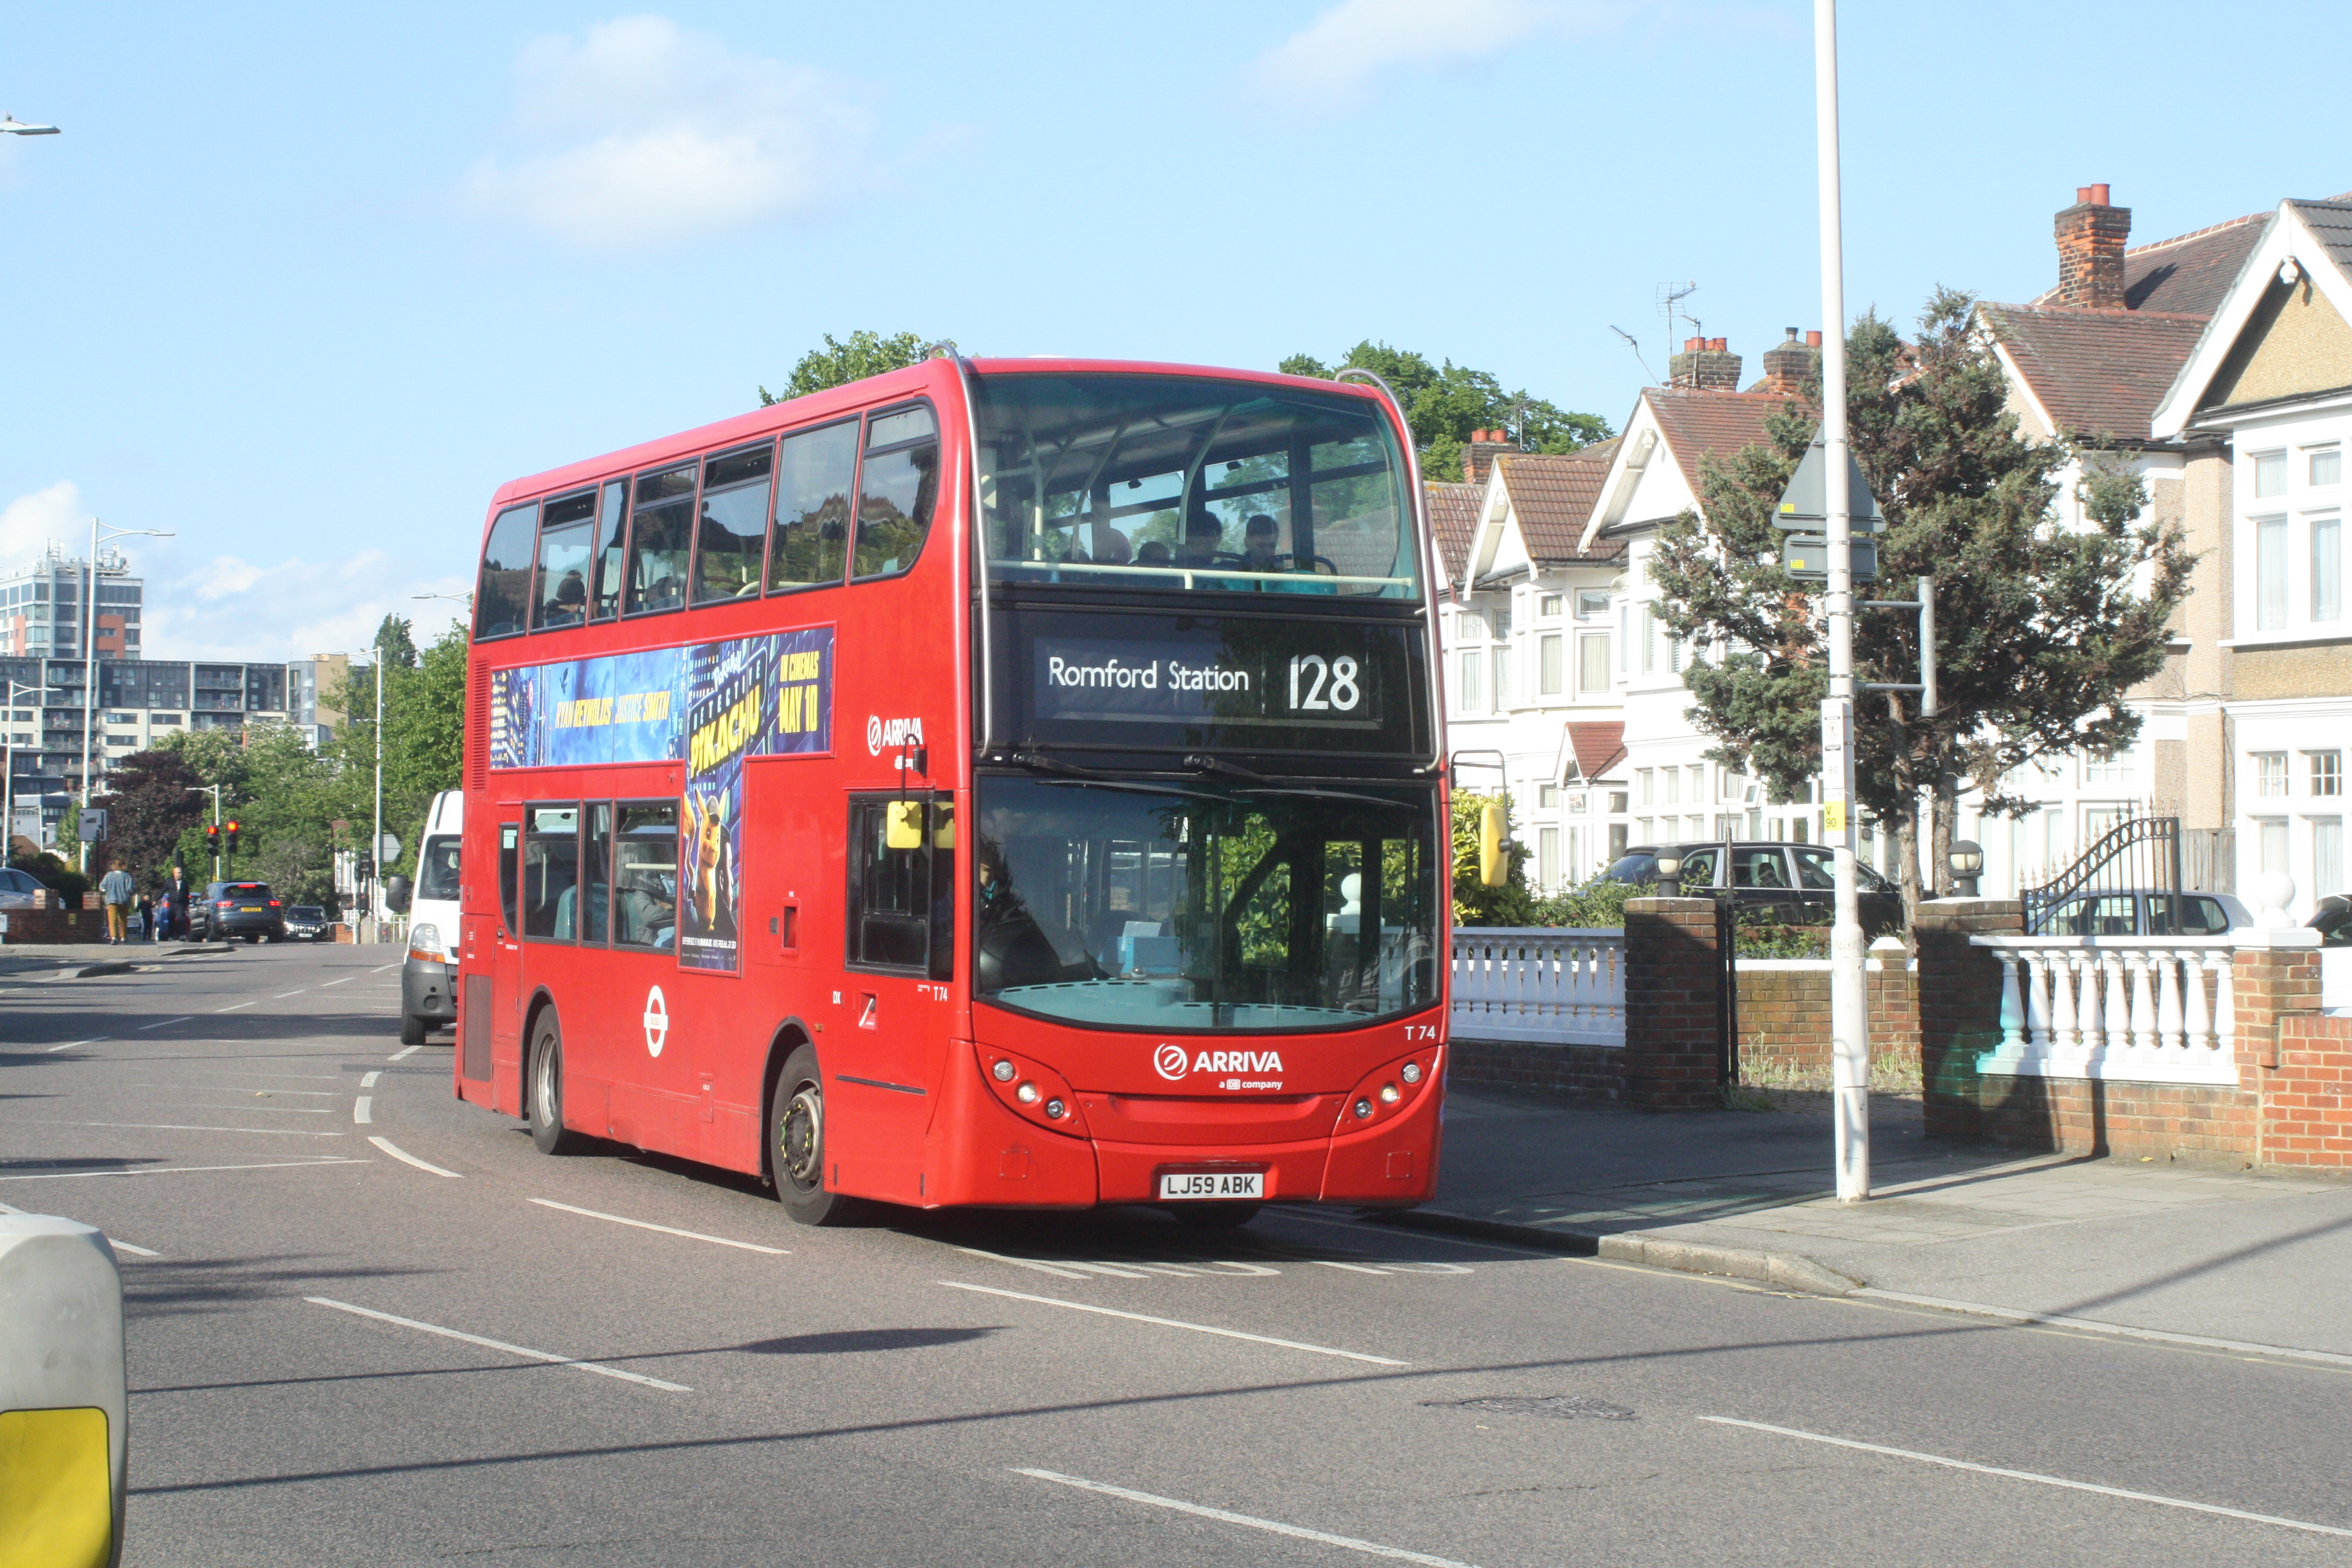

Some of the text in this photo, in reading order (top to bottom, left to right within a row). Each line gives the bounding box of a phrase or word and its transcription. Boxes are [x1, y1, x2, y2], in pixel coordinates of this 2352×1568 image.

[780, 651, 820, 682] IN CINEMAS
[1049, 656, 1249, 691] Romford Station
[693, 659, 762, 731] DETECTIVE
[1289, 654, 1360, 711] 128
[555, 697, 613, 729] RYAN REYNOLDS
[615, 690, 671, 724] JUSTICE SMITH
[779, 684, 819, 734] MAY 10
[882, 717, 924, 746] ARRIVA
[1826, 806, 1832, 815] V
[1826, 817, 1837, 828] 90
[833, 991, 841, 1004] DX
[933, 986, 939, 1001] T
[939, 987, 948, 1002] 74
[1405, 1025, 1436, 1040] T 74
[1192, 1051, 1284, 1073] ARRIVA
[1227, 1080, 1240, 1089] DB
[1242, 1080, 1283, 1091] company
[1167, 1175, 1255, 1195] LJ59 ABK
